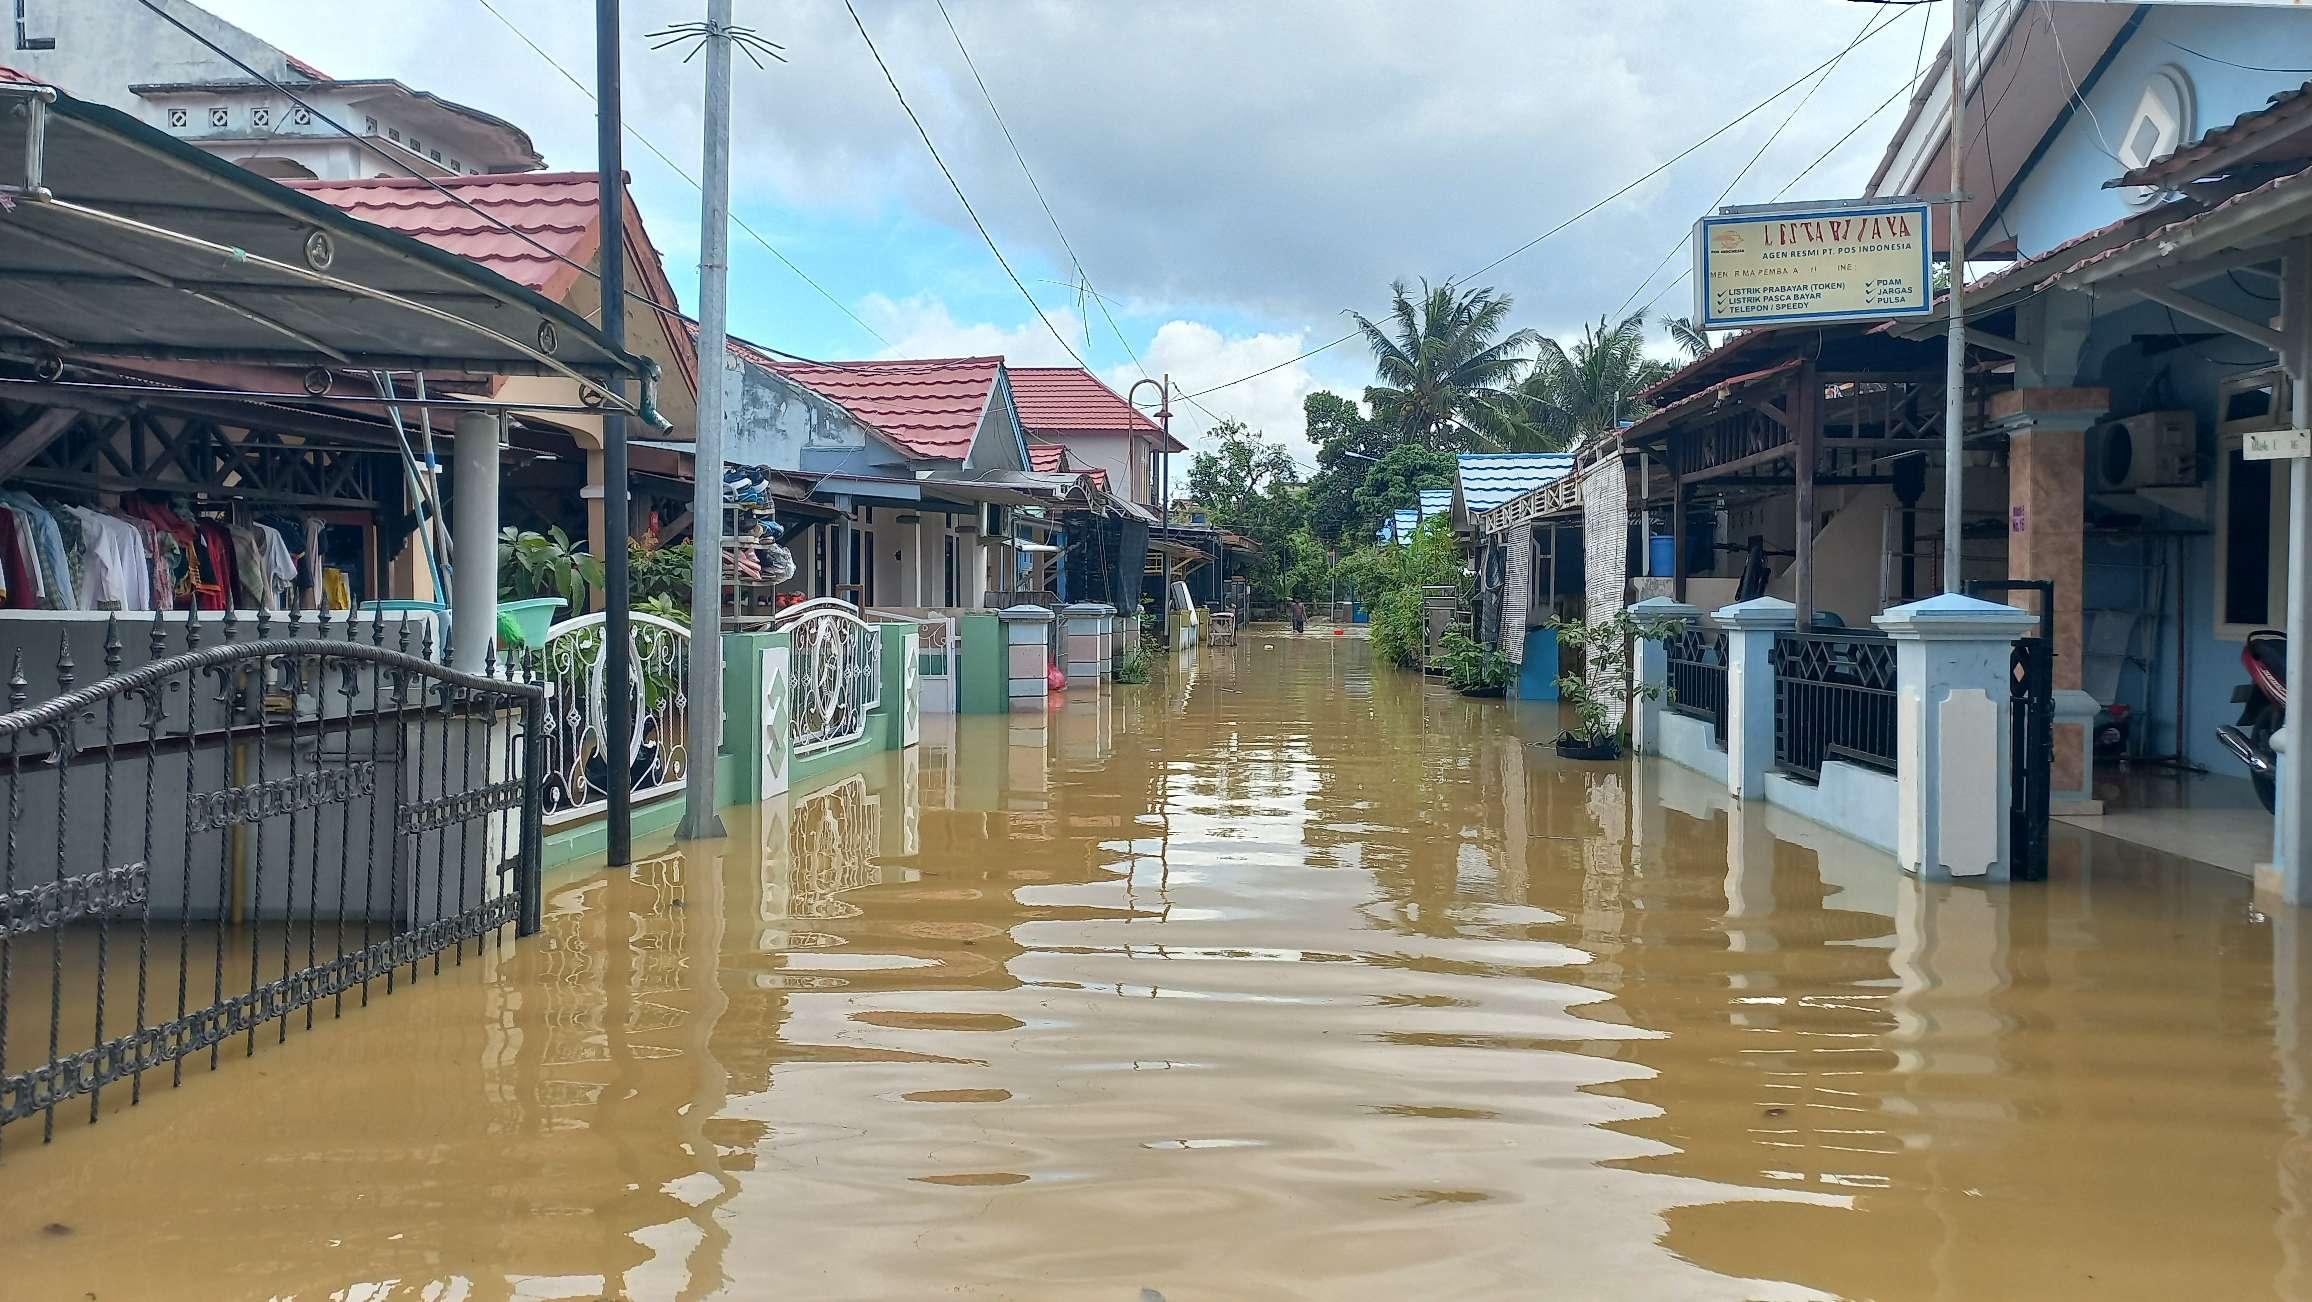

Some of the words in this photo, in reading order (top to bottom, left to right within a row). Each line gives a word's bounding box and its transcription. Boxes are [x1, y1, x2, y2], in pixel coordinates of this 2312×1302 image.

[1762, 251, 1787, 260] AGEN
[1790, 249, 1819, 258] RESMI
[1822, 248, 1835, 256] PT.
[1838, 246, 1855, 255] POS
[1859, 243, 1912, 253] INDONESIA
[1876, 278, 1902, 286] PDAM
[1728, 287, 1760, 296] LISTRIK
[1763, 284, 1808, 294] PRABAYAR
[1810, 282, 1845, 292] (TOKEN)
[1877, 287, 1912, 295] JARGAS
[1728, 296, 1760, 305] LISTRIK
[1763, 294, 1793, 302] PASCA
[1793, 292, 1821, 300] BAYAR
[1877, 296, 1906, 304] PULSA
[1729, 304, 1768, 313] TELEPON
[1775, 301, 1809, 311] SPEEDY
